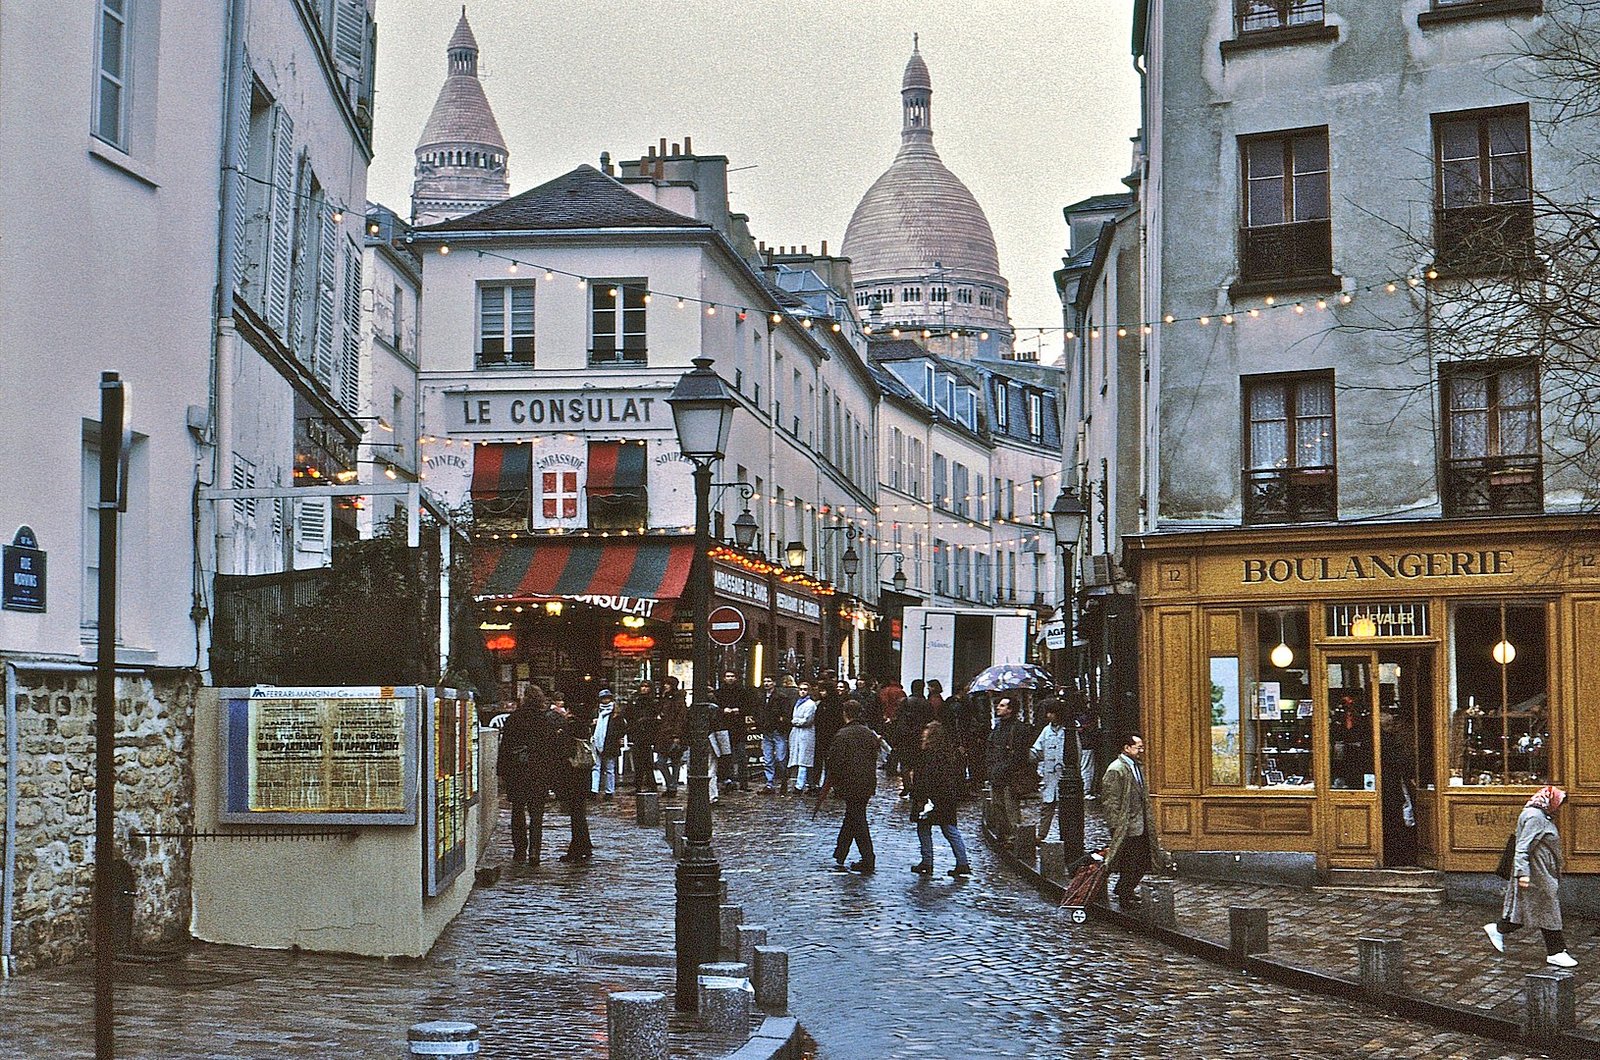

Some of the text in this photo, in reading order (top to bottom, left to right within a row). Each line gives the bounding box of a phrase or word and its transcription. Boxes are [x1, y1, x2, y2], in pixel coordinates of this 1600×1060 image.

[464, 398, 654, 424] LE CONSULAT
[426, 454, 467, 470] DINERS
[536, 453, 585, 470] AMBASSADE
[1241, 550, 1515, 585] BOULANGERIE
[1582, 553, 1595, 566] 12
[1168, 569, 1181, 581] 12
